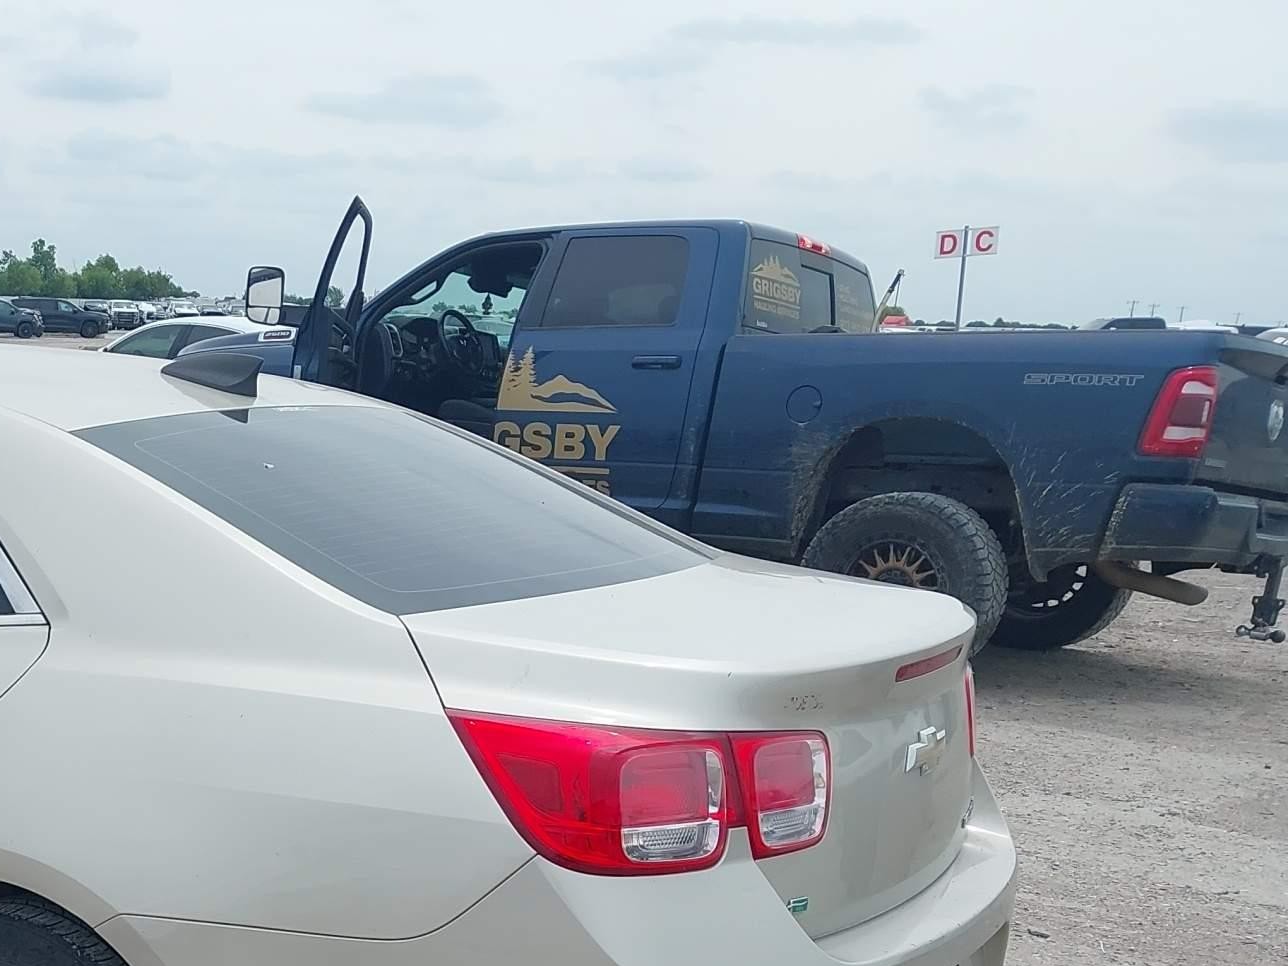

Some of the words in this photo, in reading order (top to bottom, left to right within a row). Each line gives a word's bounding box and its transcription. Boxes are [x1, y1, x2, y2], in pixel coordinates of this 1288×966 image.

[939, 233, 958, 255] D
[975, 230, 994, 252] C
[753, 277, 801, 304] GRIGSBY
[1023, 373, 1144, 386] SPORT
